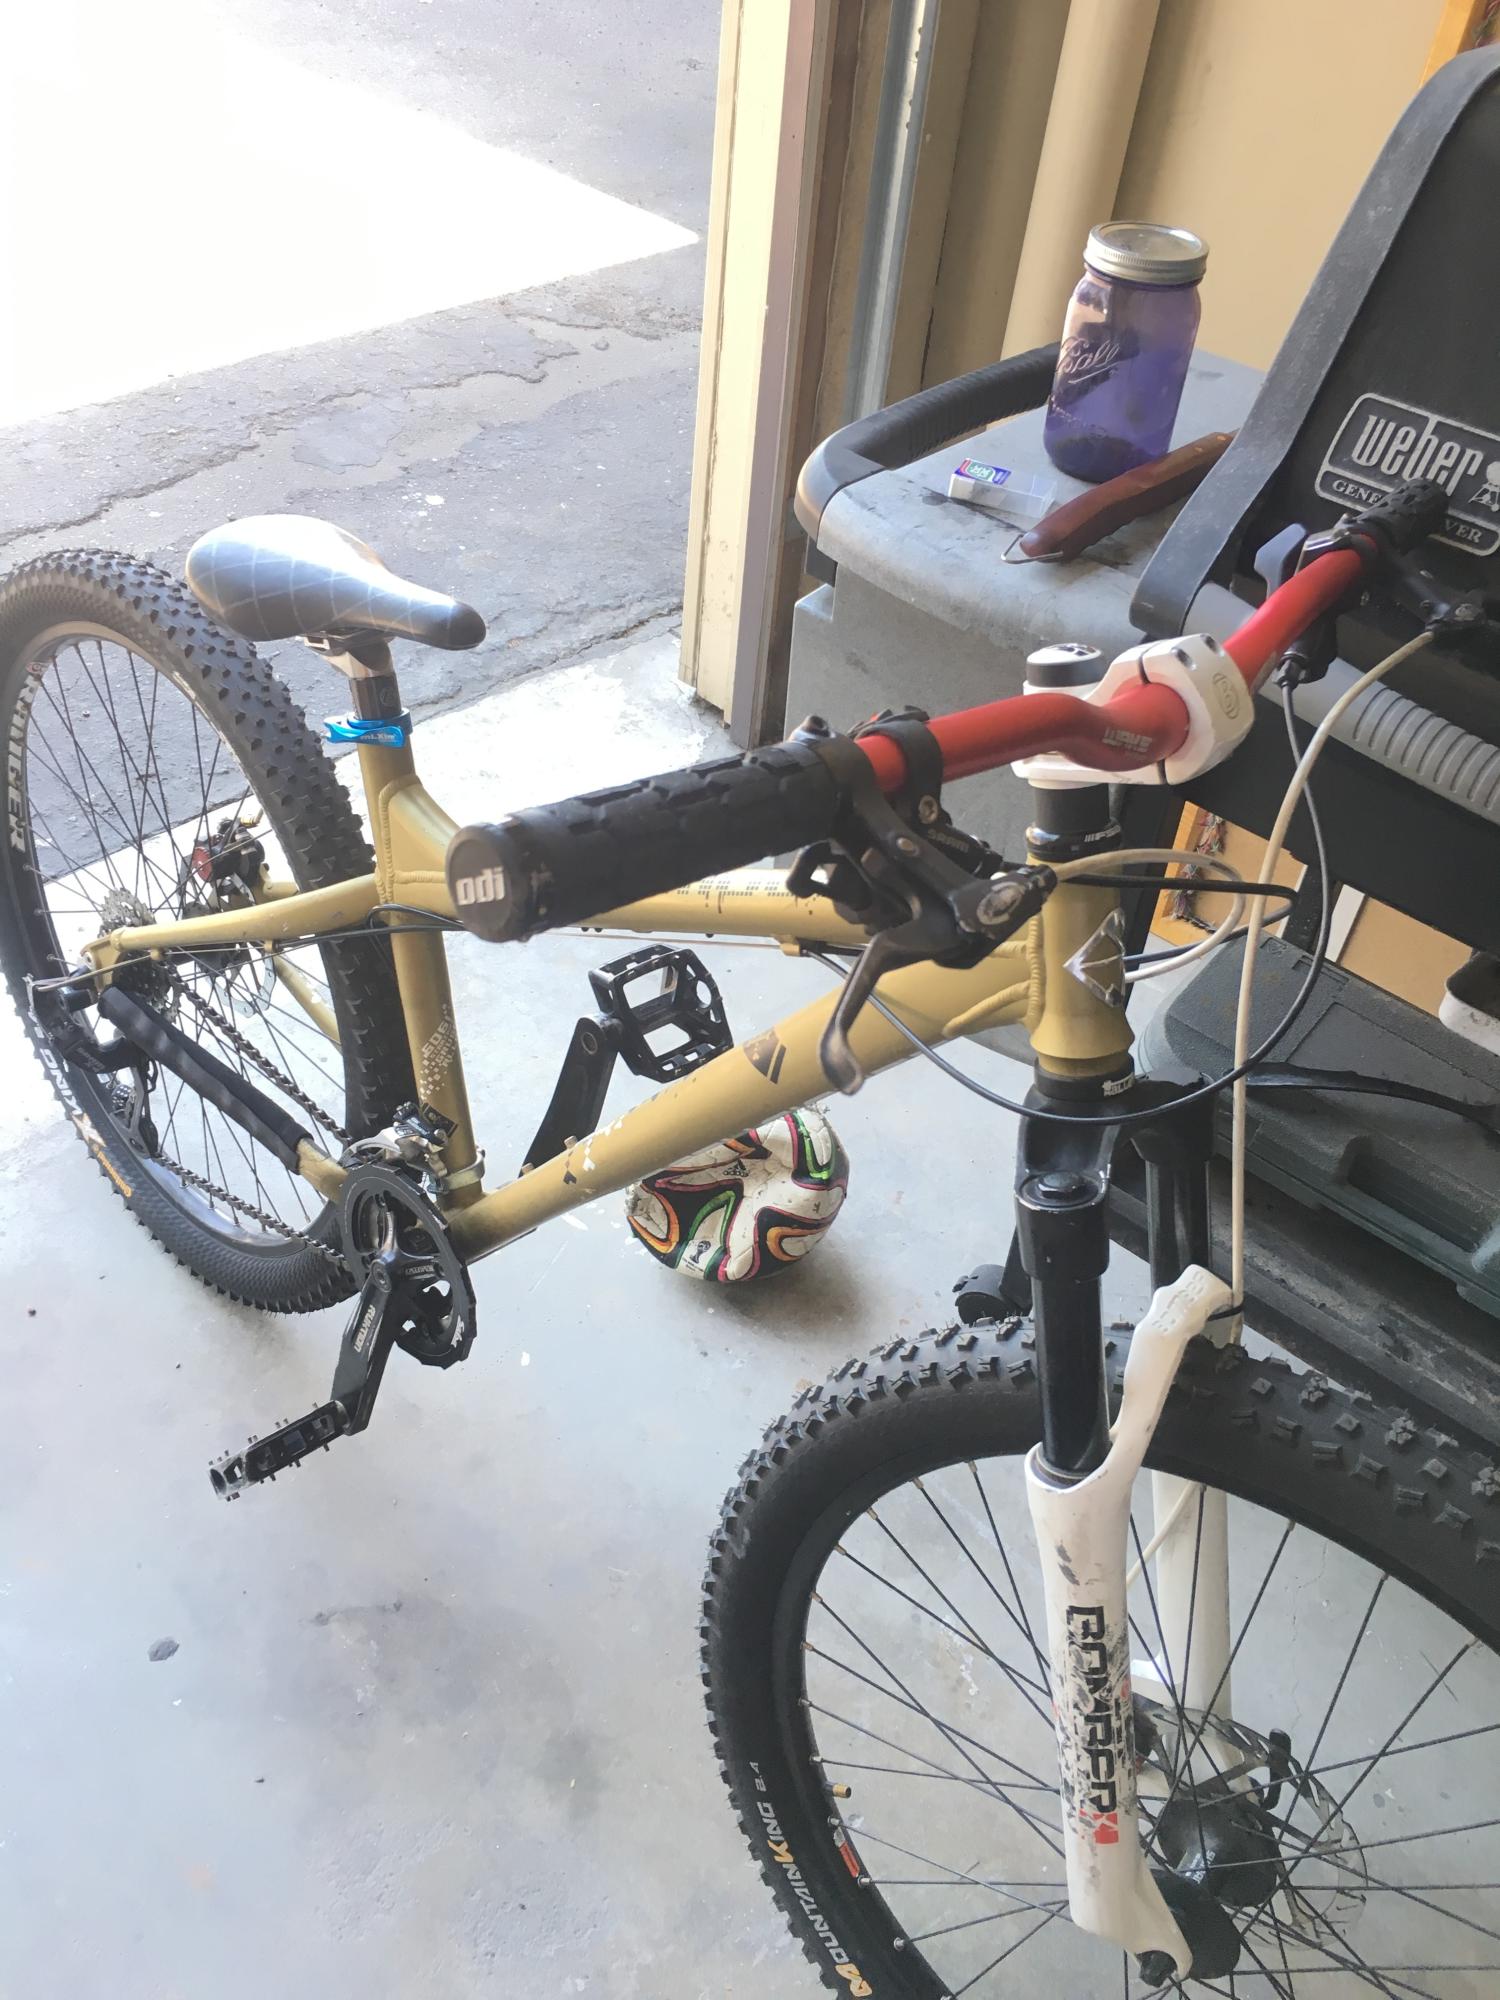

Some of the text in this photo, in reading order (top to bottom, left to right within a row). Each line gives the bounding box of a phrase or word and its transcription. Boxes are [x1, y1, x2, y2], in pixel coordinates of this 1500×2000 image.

[1056, 336, 1120, 374] Ball
[1332, 479, 1484, 544] GENE VER
[8, 674, 41, 854] RANGER
[455, 866, 506, 906] odi
[1065, 1605, 1117, 1814] BOMBER
